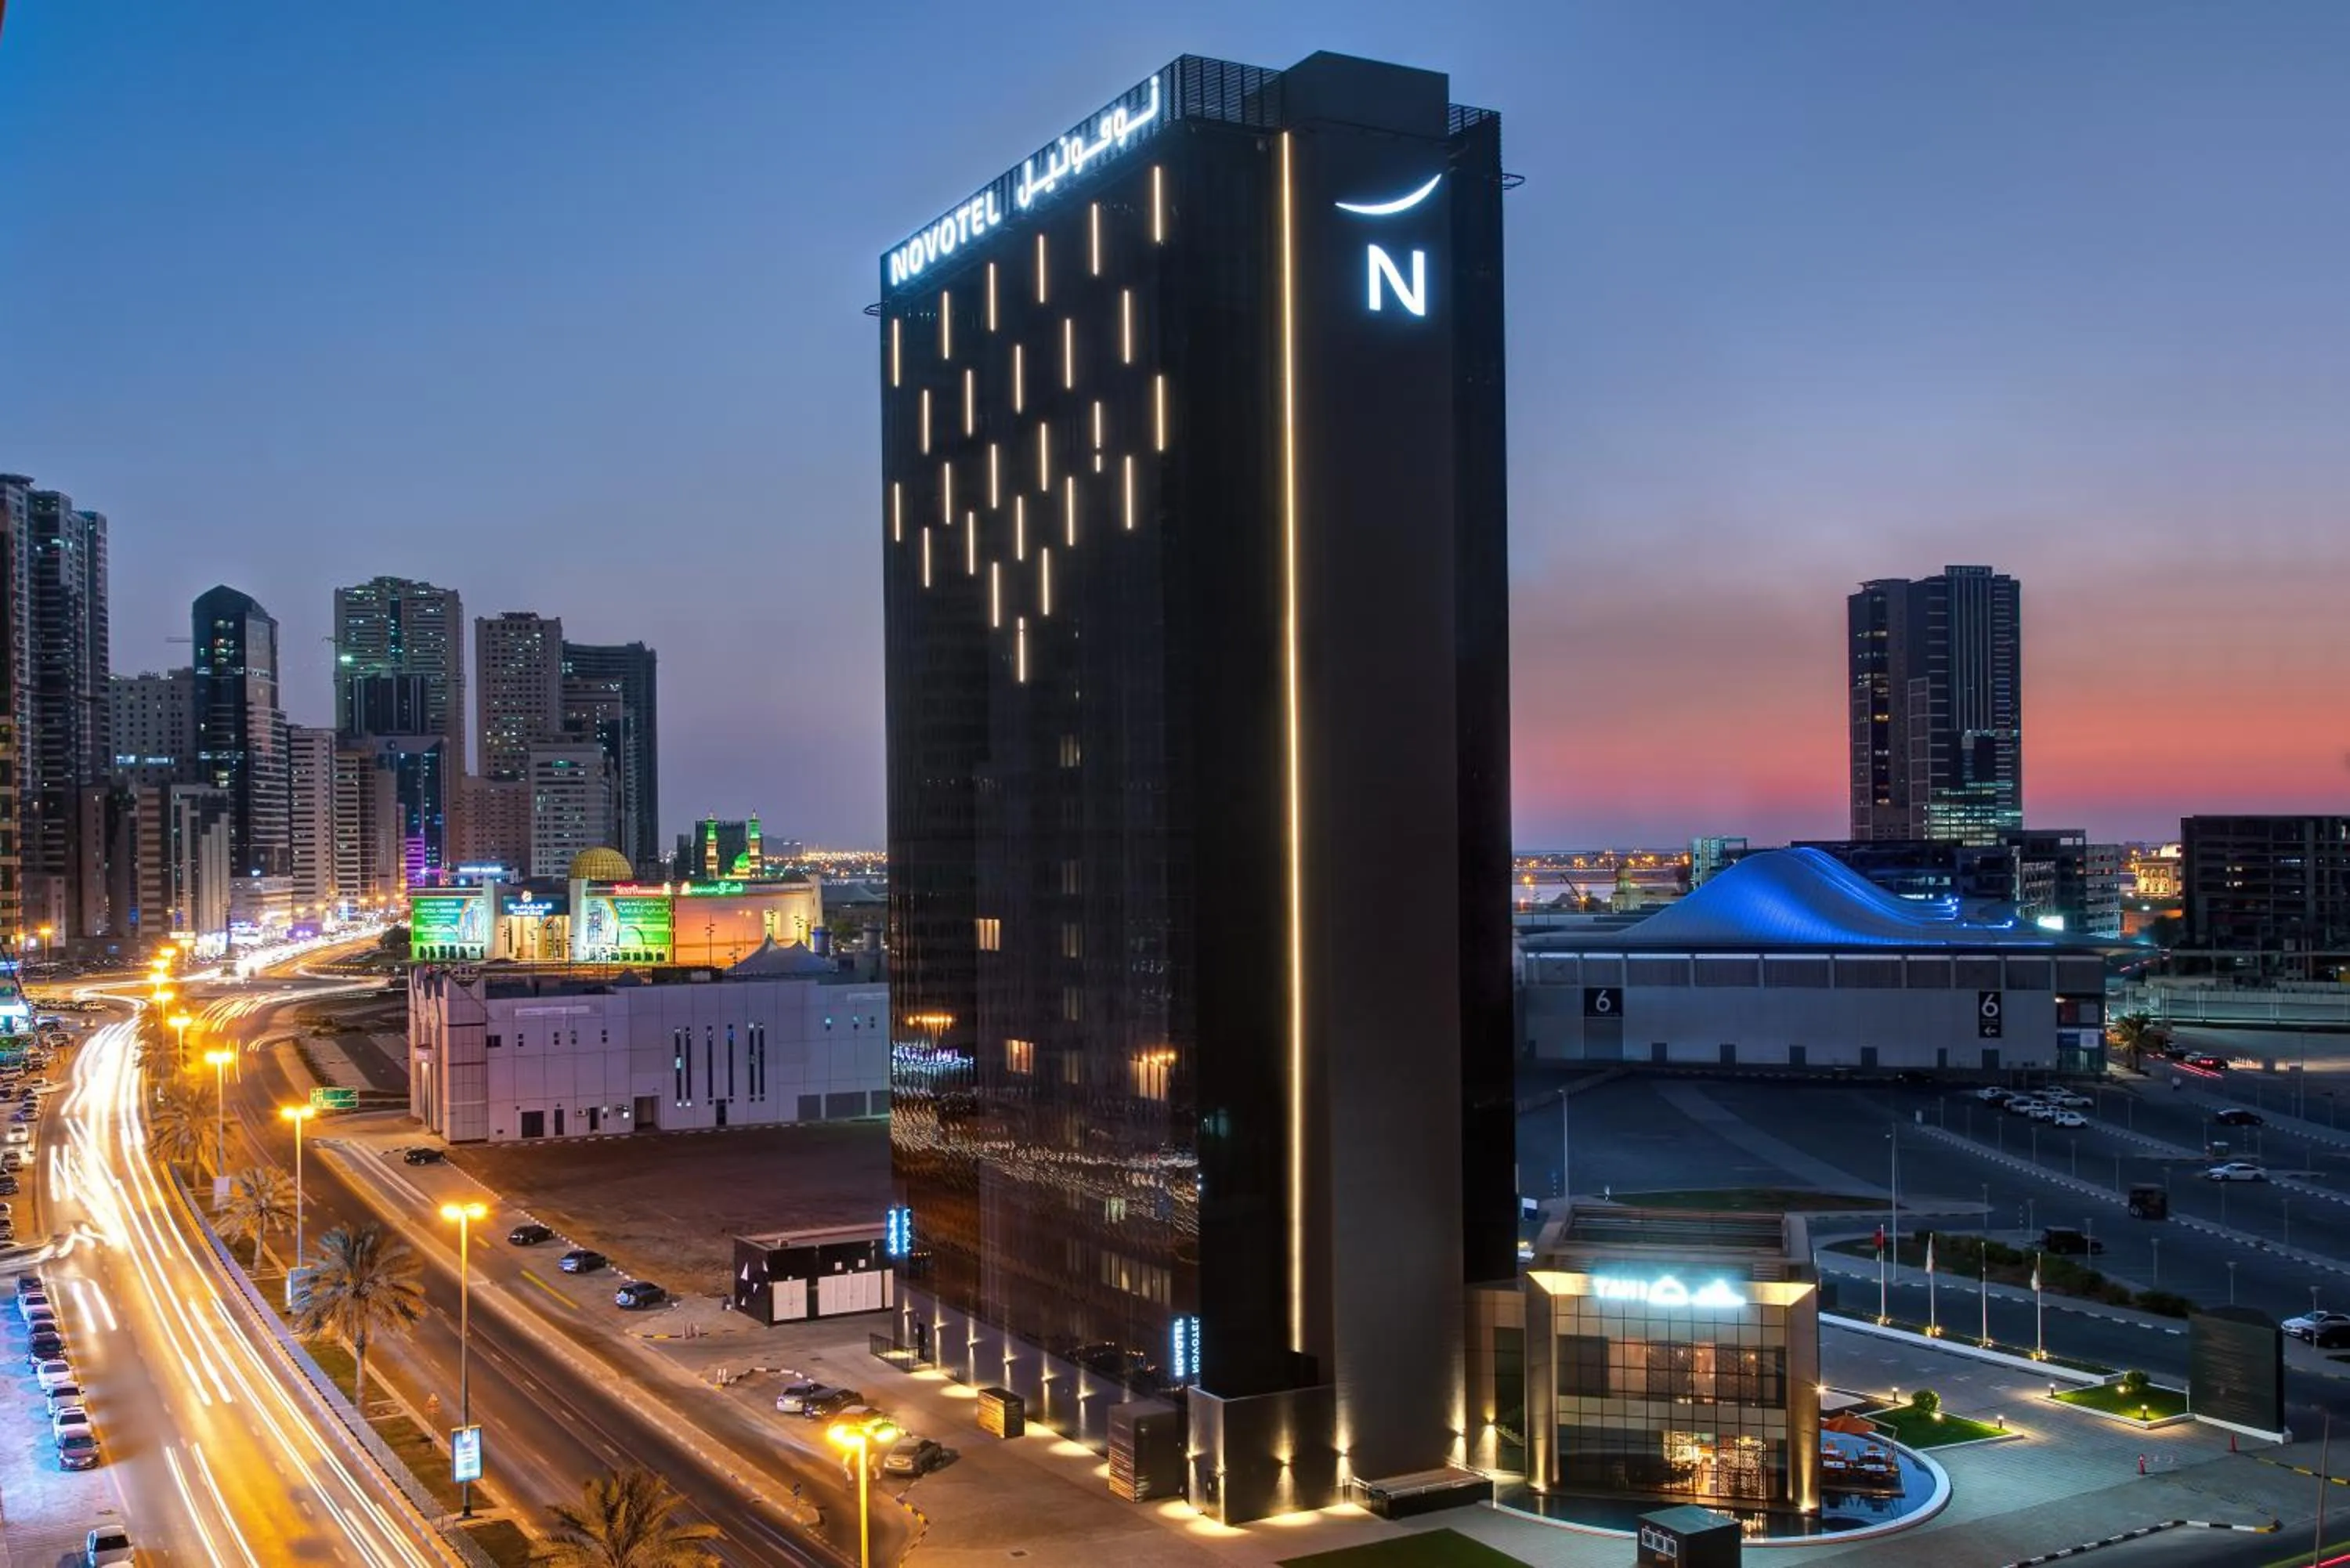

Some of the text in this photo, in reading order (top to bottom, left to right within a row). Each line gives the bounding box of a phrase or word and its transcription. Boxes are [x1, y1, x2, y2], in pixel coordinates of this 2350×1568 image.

[890, 190, 1000, 287] NOVOTEL
[1368, 244, 1426, 316] N
[1596, 989, 1611, 1012] 6
[1981, 993, 1999, 1017] 6
[1173, 1317, 1184, 1377] NOVOTEL
